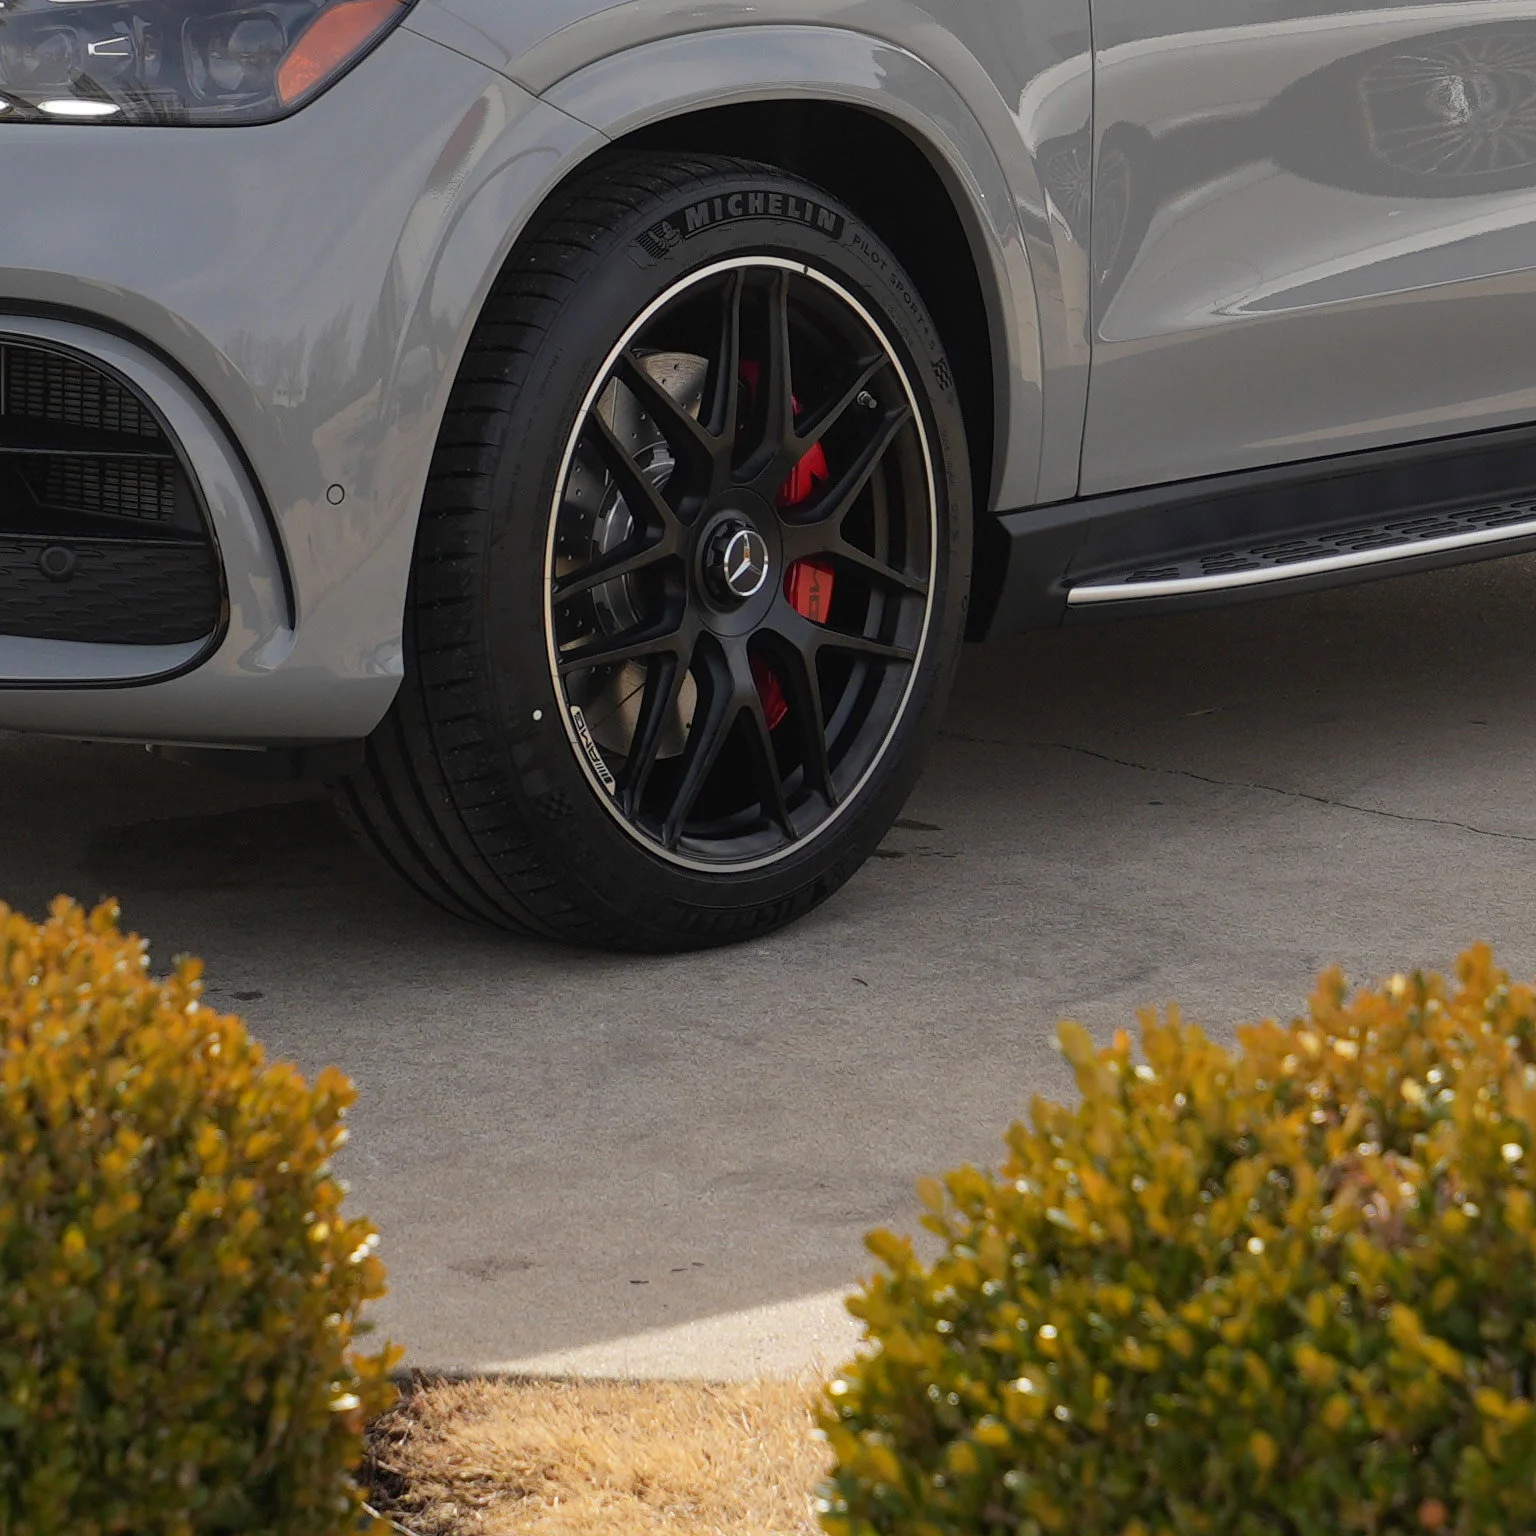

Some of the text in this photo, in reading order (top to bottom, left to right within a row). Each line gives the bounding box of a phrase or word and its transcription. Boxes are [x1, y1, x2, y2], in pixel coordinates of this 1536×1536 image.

[684, 192, 837, 233] MICHELIN
[852, 233, 887, 271] PILOT
[890, 272, 925, 323] SPORT
